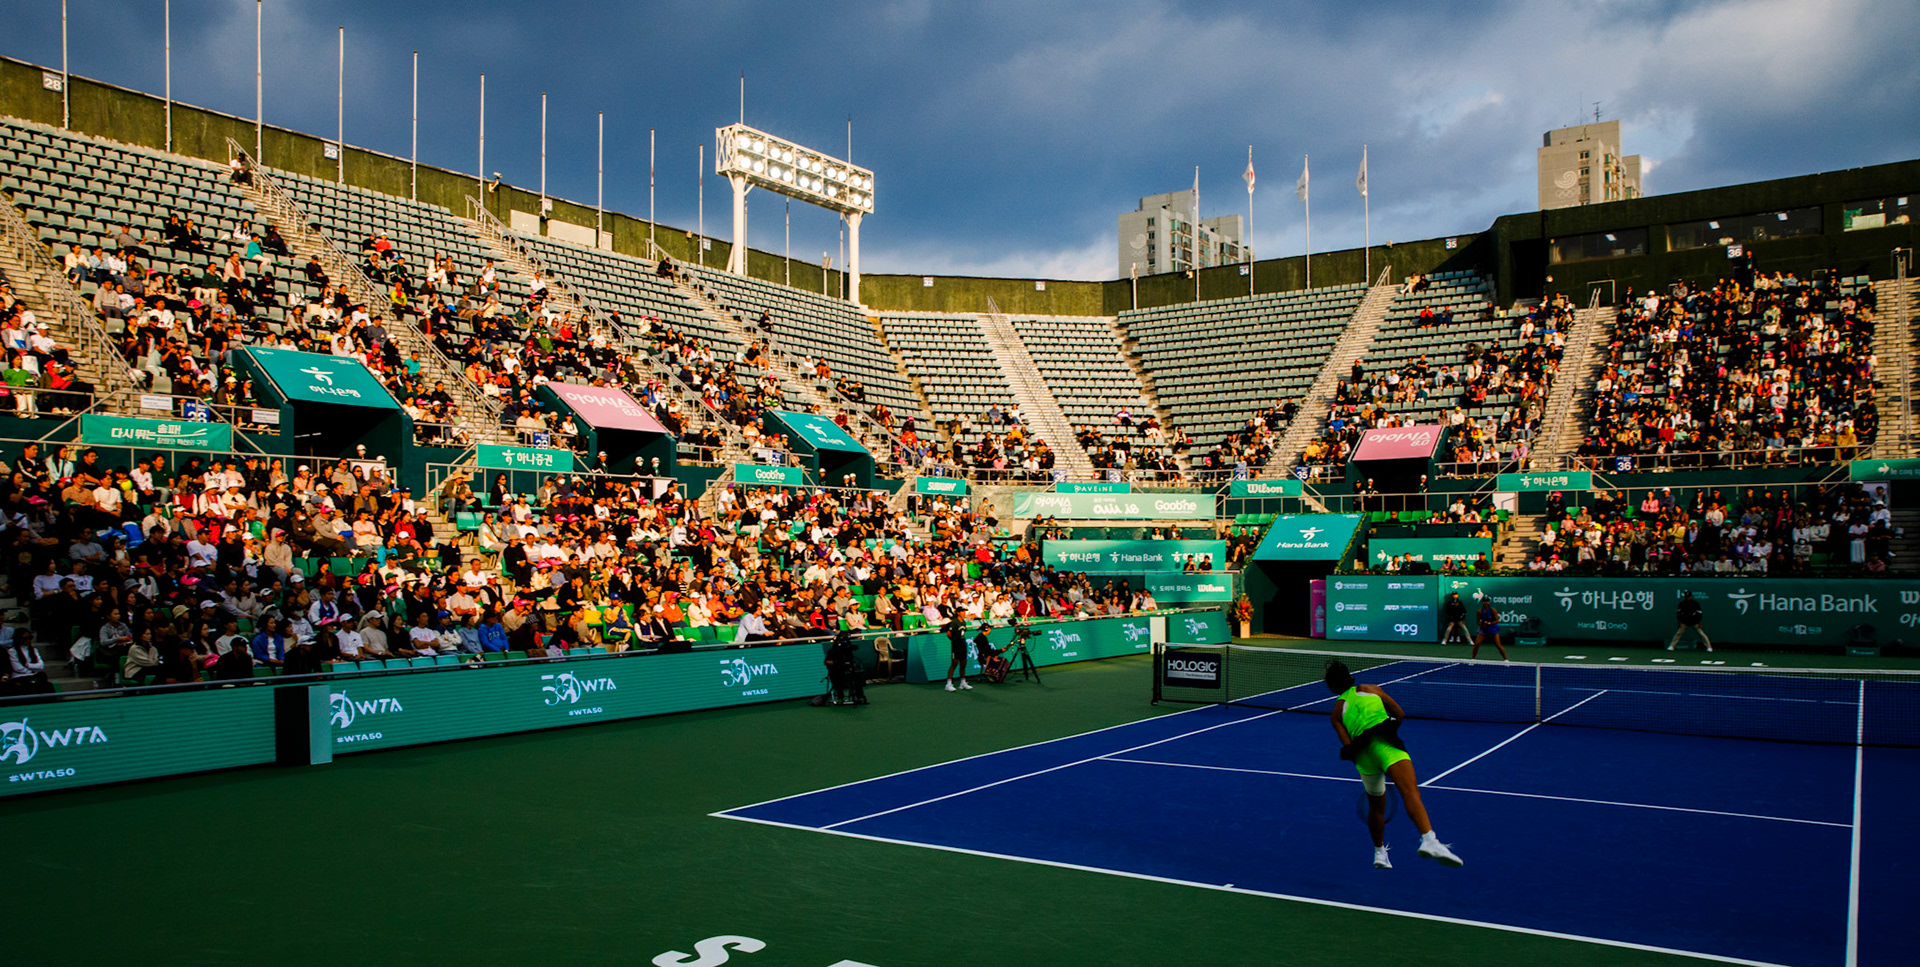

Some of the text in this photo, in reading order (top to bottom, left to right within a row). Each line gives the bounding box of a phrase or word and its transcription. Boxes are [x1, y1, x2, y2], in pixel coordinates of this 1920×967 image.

[44, 78, 61, 90] 28
[325, 148, 337, 158] 29
[1446, 241, 1457, 249] 35
[1728, 249, 1742, 258] 36
[1239, 268, 1249, 276] 34
[566, 392, 636, 408] 아이시스
[621, 408, 642, 417] 8.0
[111, 428, 132, 438] 다시
[135, 429, 156, 440] 뛰는
[1368, 431, 1431, 443] 아이시스
[517, 452, 553, 467] 하나증권
[1617, 461, 1632, 470] 36
[1297, 470, 1308, 480] 35
[1533, 475, 1568, 487] 하나은행
[1247, 483, 1284, 494] Wilson
[1069, 553, 1100, 562] 하나은행
[1121, 553, 1163, 562] Hana Bank
[1493, 596, 1506, 604] coq
[1508, 594, 1532, 605] sportif
[1582, 590, 1654, 610] 하나은행
[1759, 593, 1878, 613] Hana Bank
[1394, 624, 1418, 635] apg
[1577, 621, 1595, 629] Hana
[1608, 622, 1628, 630] OneQ
[750, 663, 779, 676] WTA
[1167, 659, 1217, 673] HOLOGIC
[580, 678, 617, 692] WTA
[356, 698, 403, 716] WTA
[568, 707, 603, 716] #WTA50
[40, 726, 108, 748] WTA
[337, 732, 382, 743] #WTA50
[8, 767, 76, 783] #WTA50
